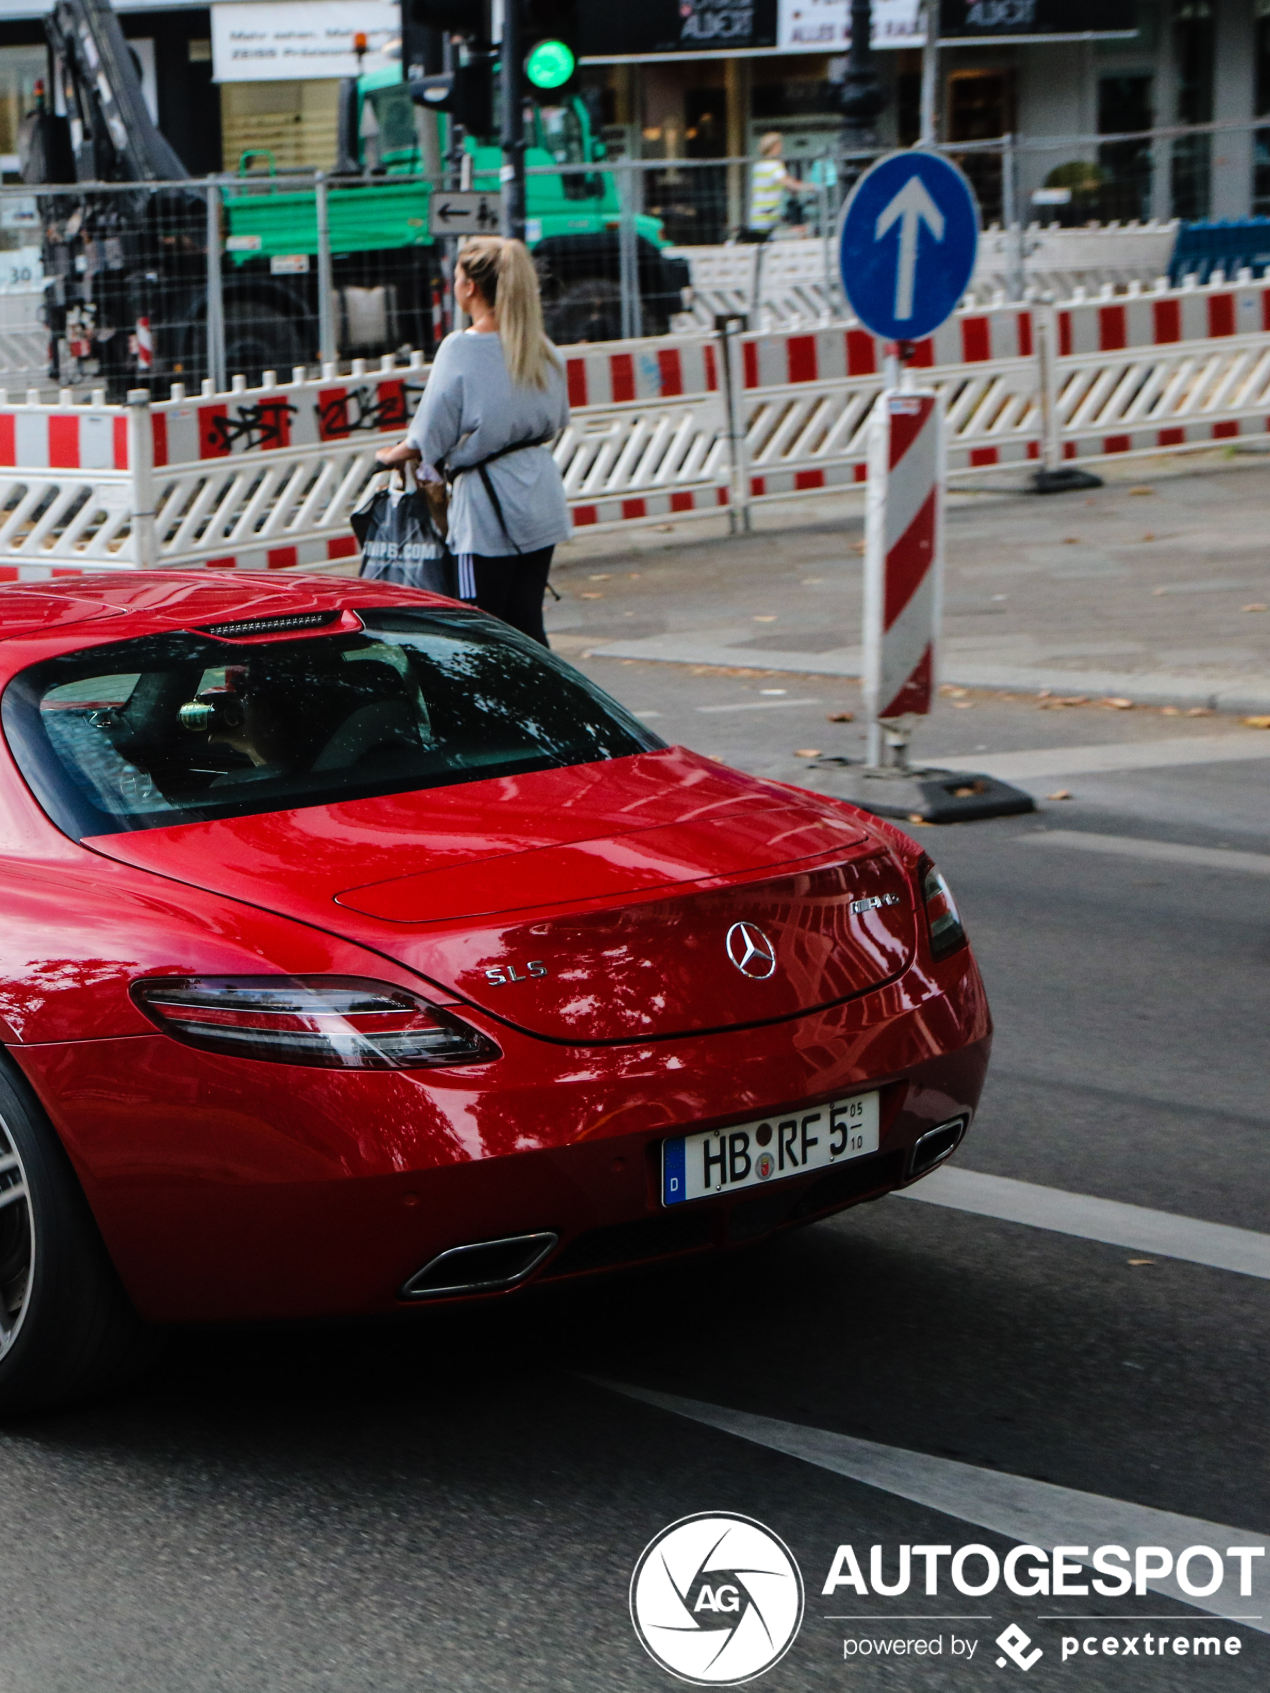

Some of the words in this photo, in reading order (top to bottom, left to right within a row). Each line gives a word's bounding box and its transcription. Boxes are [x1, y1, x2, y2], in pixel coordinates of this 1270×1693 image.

[11, 266, 32, 284] 30
[485, 960, 548, 986] SLS
[850, 1102, 863, 1117] 05
[703, 1131, 752, 1189] HB
[778, 1113, 821, 1171] RF
[830, 1106, 848, 1156] 5
[850, 1134, 863, 1151] 10
[670, 1177, 679, 1192] D
